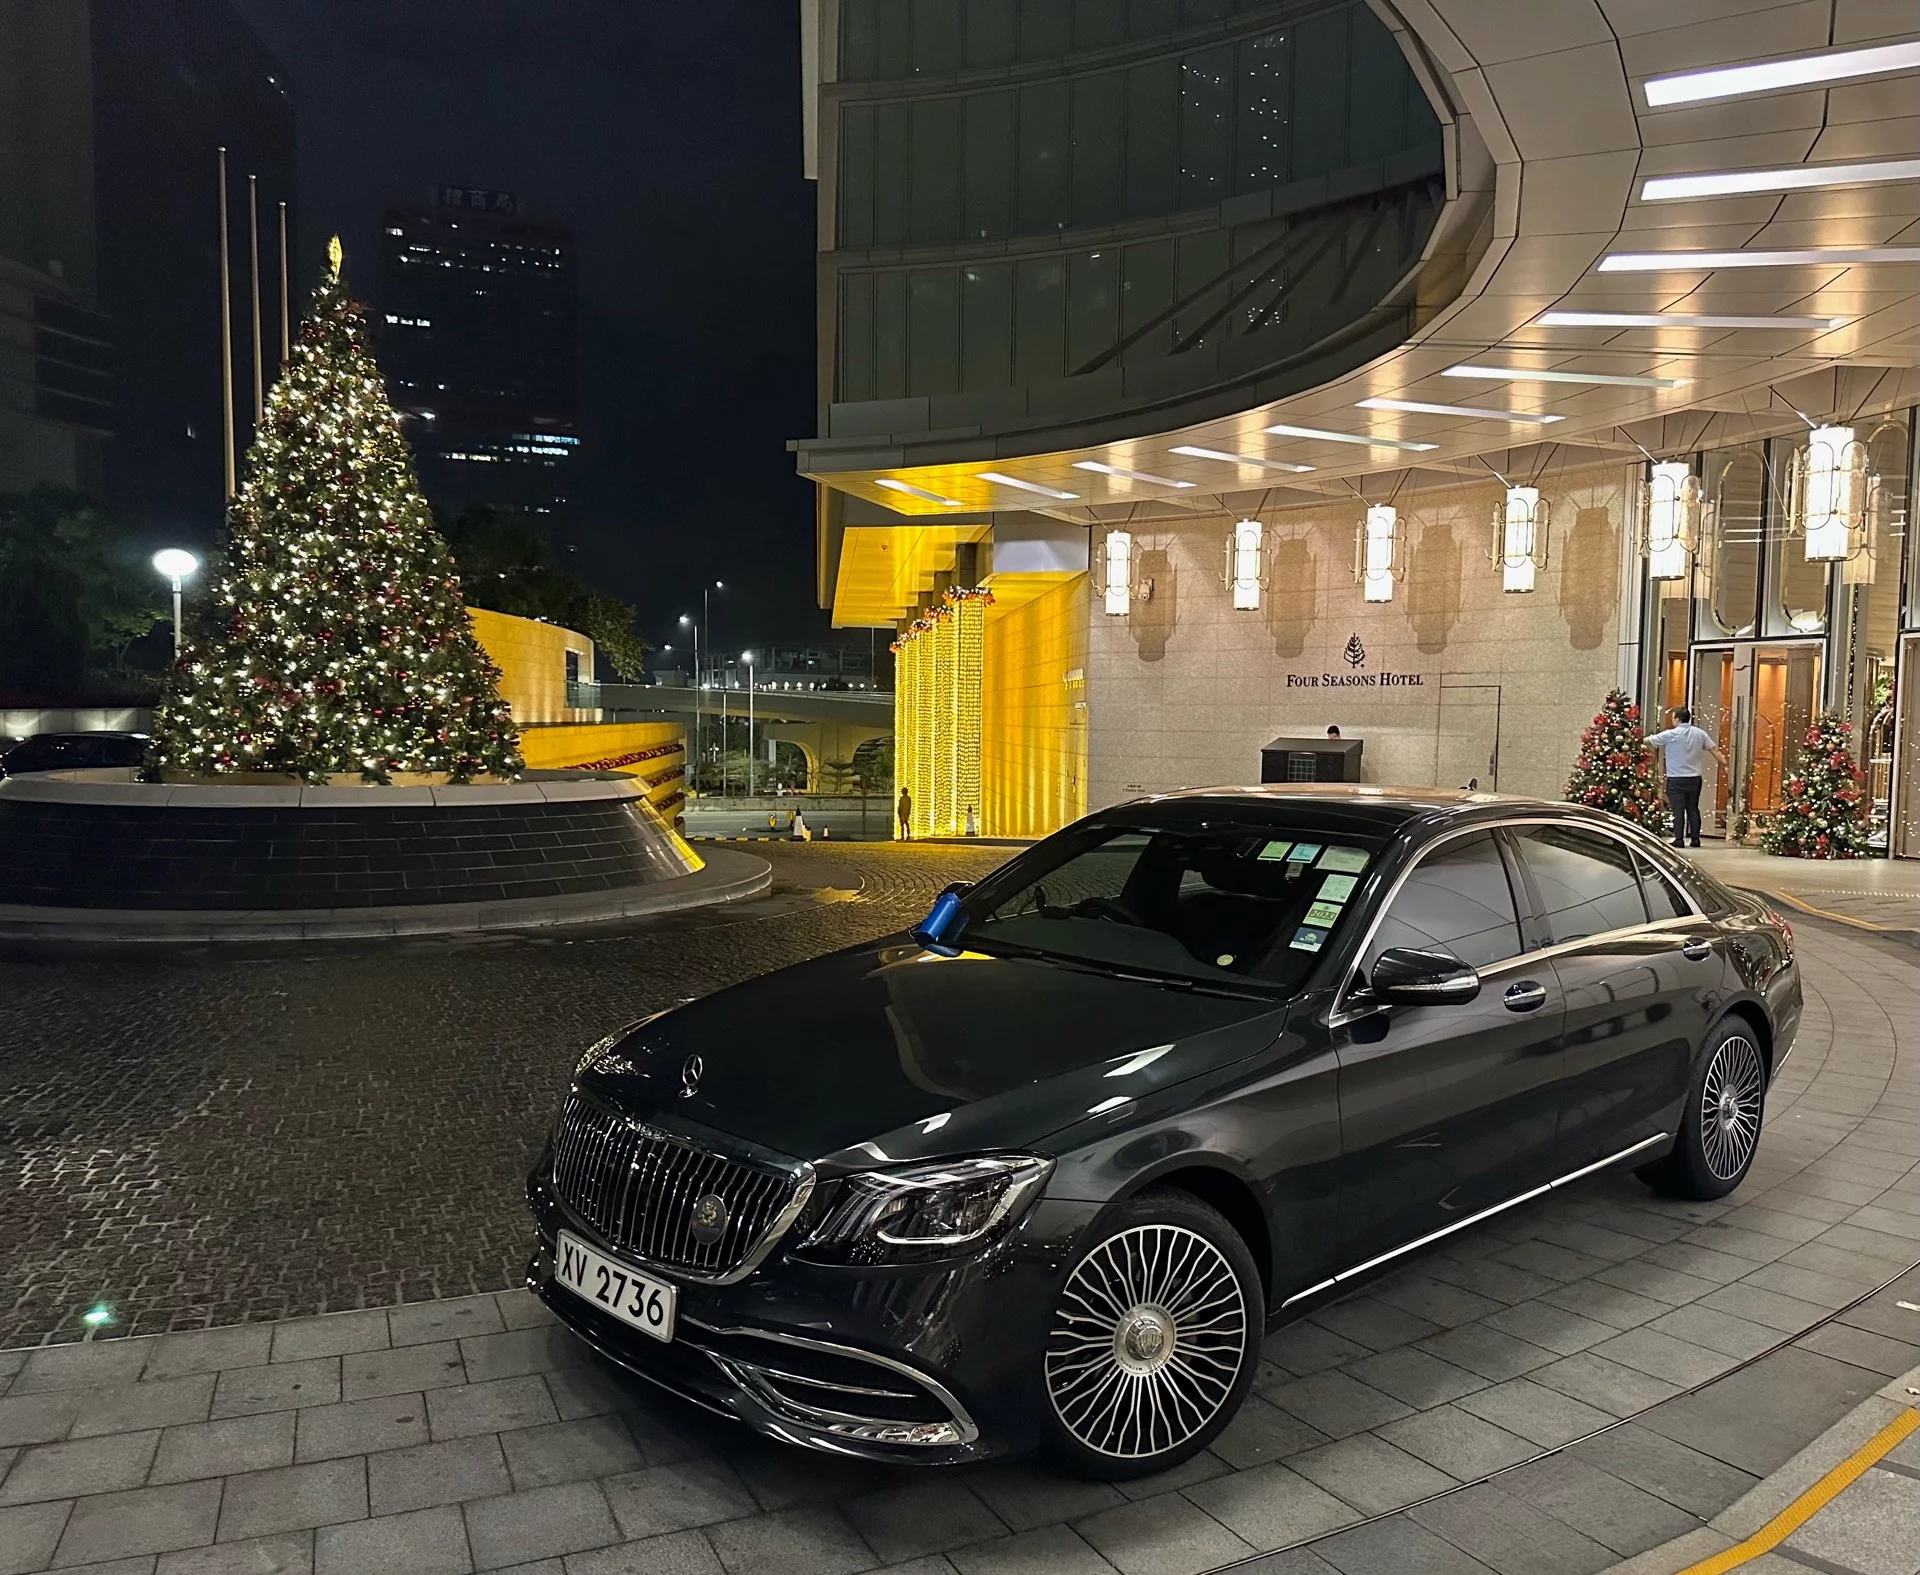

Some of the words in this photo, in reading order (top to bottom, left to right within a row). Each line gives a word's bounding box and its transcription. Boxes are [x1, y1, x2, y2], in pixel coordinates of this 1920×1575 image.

[1286, 674, 1319, 687] FOUR
[1322, 673, 1376, 687] SEASONS
[1379, 672, 1424, 686] HOTEL
[561, 1241, 587, 1288] XV
[595, 1265, 664, 1327] 2736
